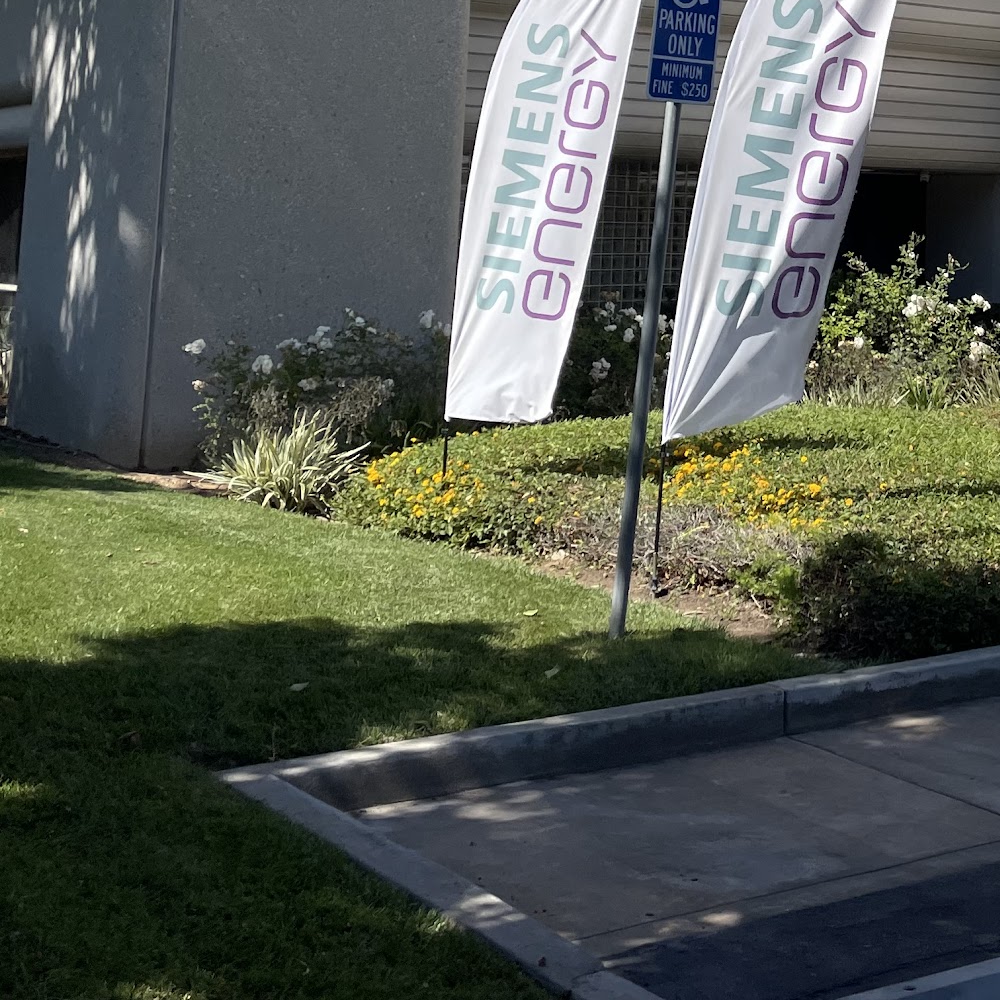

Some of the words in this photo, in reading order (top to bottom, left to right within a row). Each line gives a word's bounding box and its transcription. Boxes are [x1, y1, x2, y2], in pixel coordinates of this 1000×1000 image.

[658, 8, 715, 34] PARKING
[668, 33, 703, 56] ONLY
[661, 63, 703, 79] MINIMUM
[652, 79, 674, 95] FINE
[680, 82, 708, 98] $250
[475, 22, 569, 314] SIEMENS
